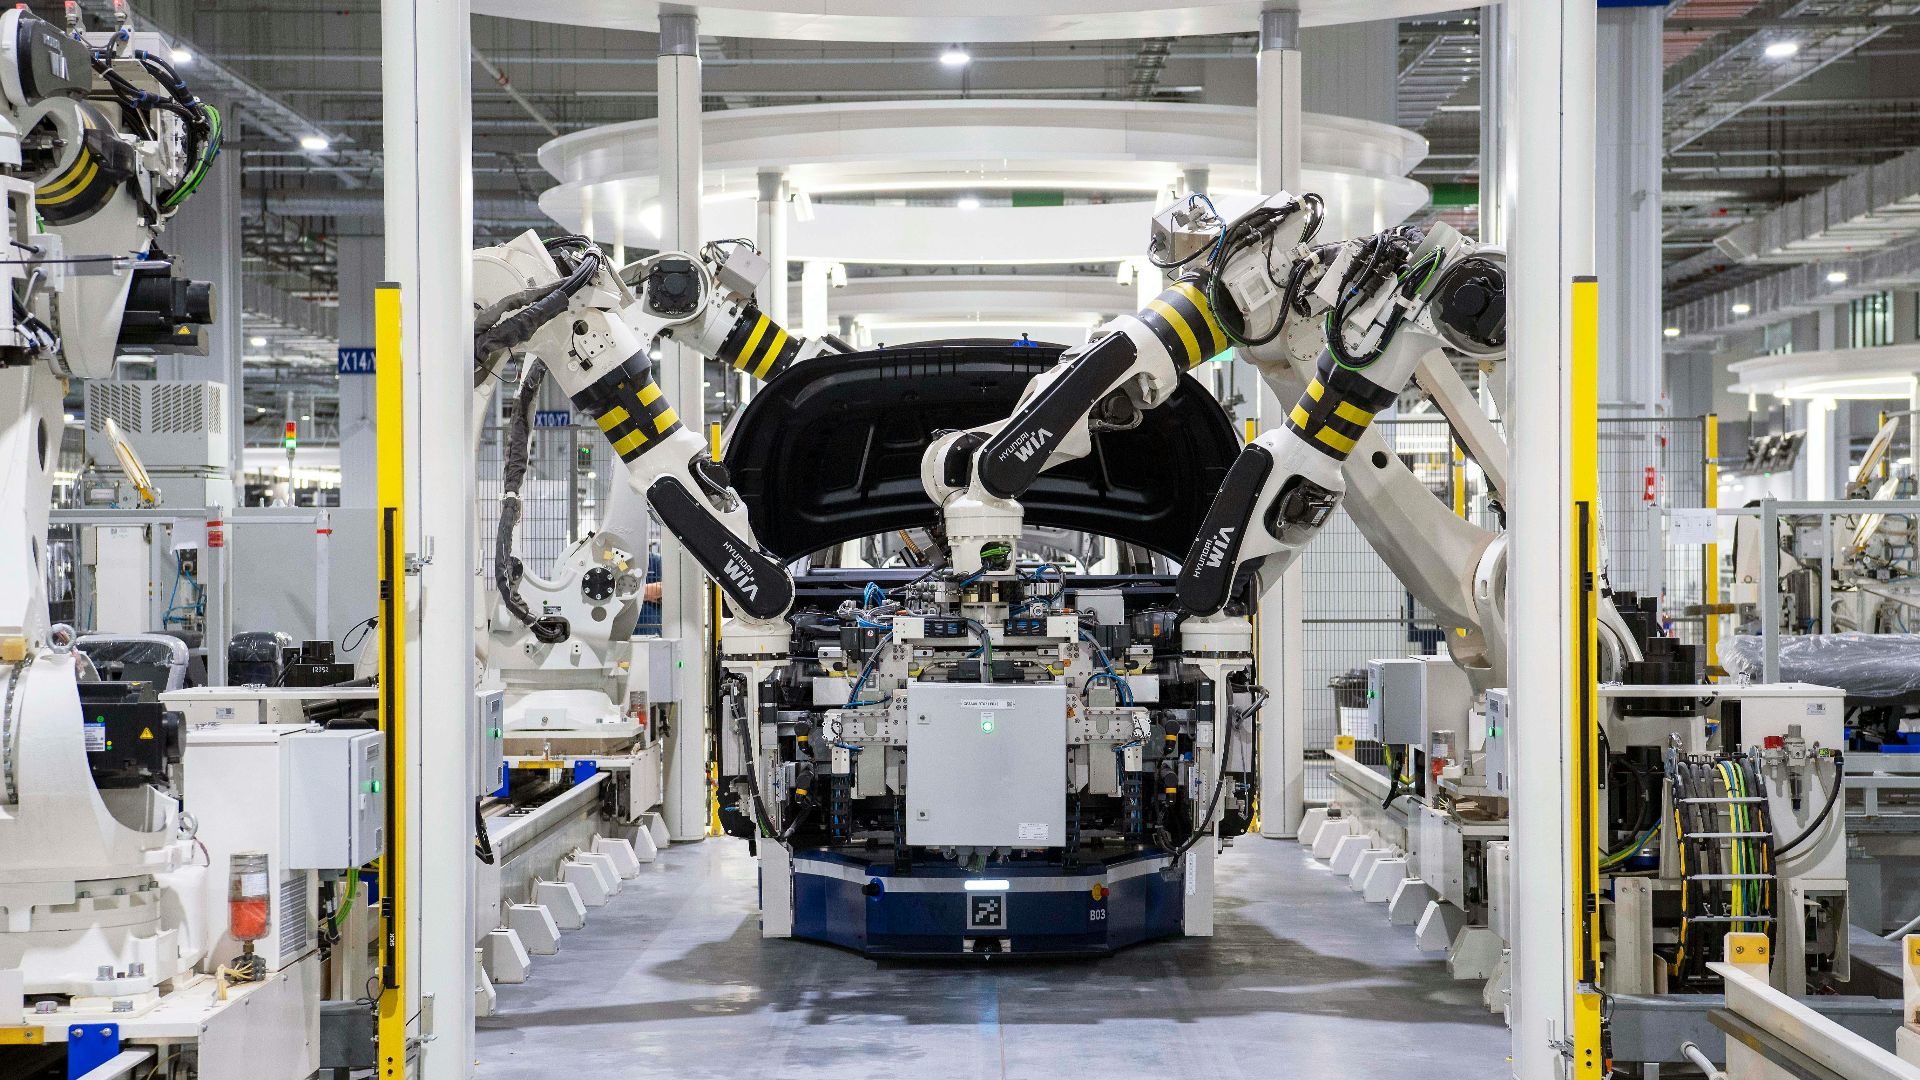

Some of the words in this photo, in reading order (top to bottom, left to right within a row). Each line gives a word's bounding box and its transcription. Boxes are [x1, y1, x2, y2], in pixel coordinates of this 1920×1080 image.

[998, 431, 1030, 462] HYUNDAI
[722, 541, 754, 575] HYUNDAI
[1192, 539, 1213, 578] HYUNDAI
[1090, 908, 1106, 921] B03
